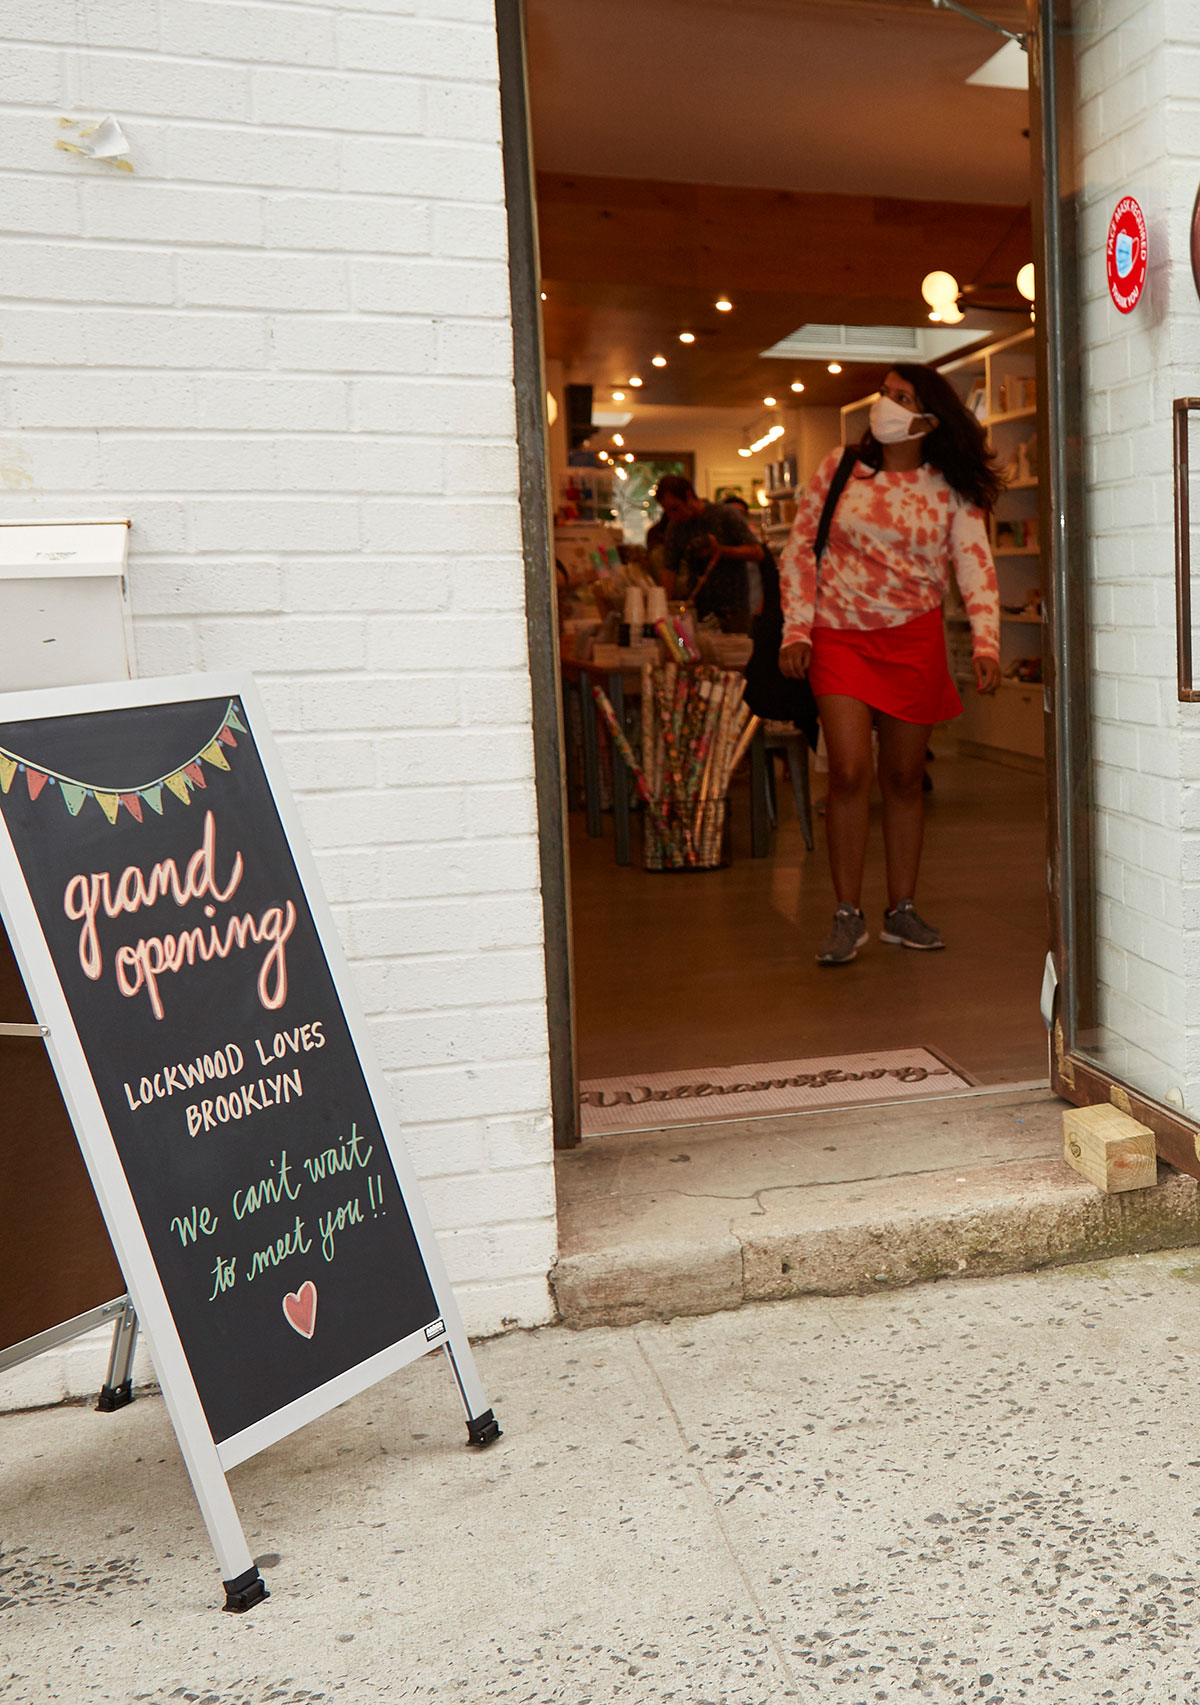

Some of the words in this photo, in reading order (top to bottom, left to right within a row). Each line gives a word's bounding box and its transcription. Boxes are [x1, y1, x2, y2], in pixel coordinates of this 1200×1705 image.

[64, 810, 243, 980] grand
[115, 900, 296, 1020] opening
[124, 1043, 244, 1111] LOCKWOOD
[254, 1021, 326, 1066] LOVES
[186, 1069, 303, 1138] BROOKLYN
[233, 1151, 301, 1220] can't
[304, 1123, 373, 1182] wait
[209, 1257, 237, 1301] to
[247, 1216, 312, 1281] meet
